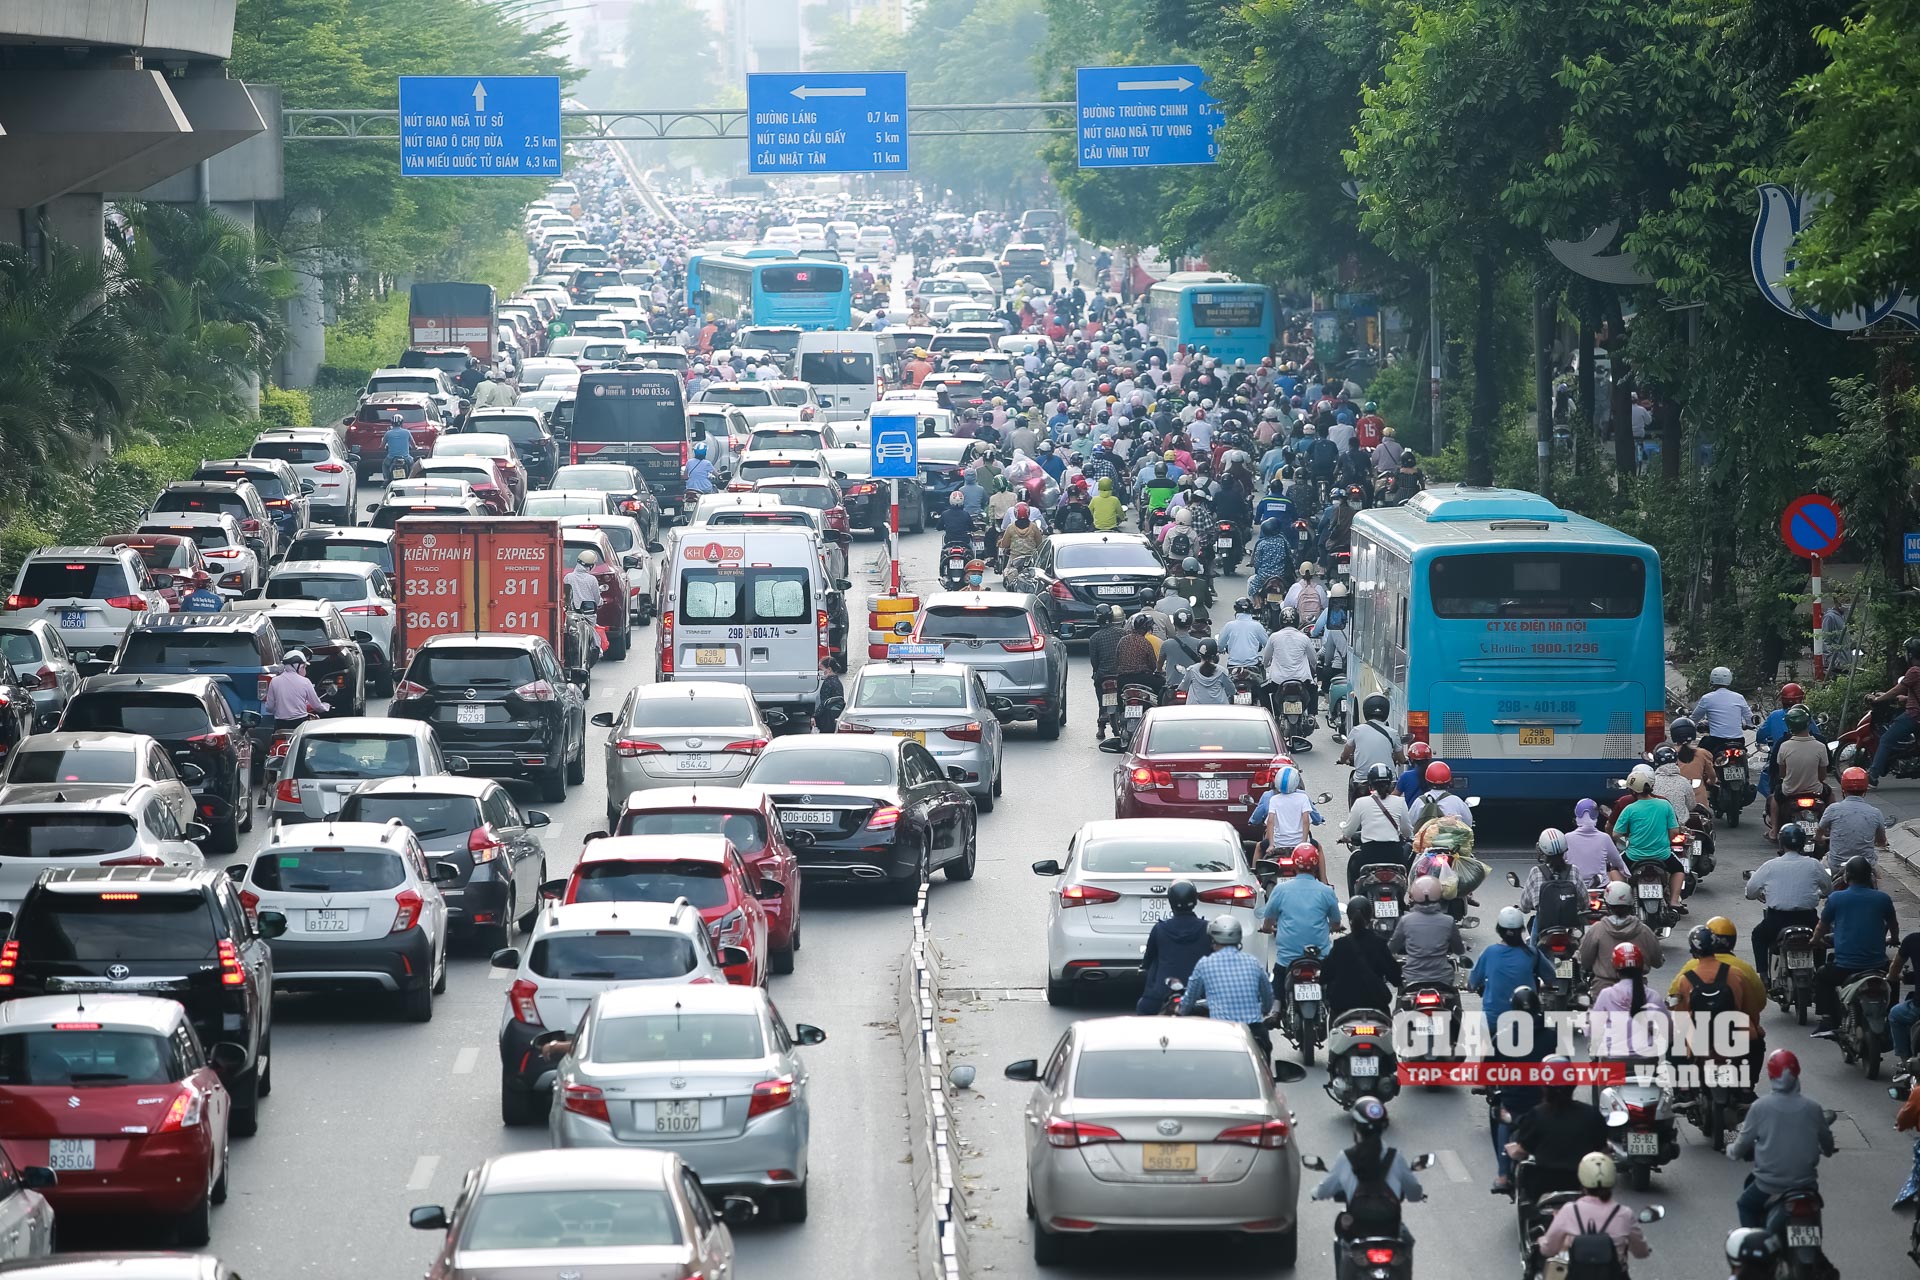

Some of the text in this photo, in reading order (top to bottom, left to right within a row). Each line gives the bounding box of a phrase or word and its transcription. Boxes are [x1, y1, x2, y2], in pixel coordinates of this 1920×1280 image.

[1083, 104, 1115, 118] ĐƯỜNG
[1119, 102, 1156, 118] TRƯỜNG
[1160, 104, 1188, 116] CHINH
[404, 112, 504, 127] NÚT GIAO NGÃ TƯ SỞ
[756, 110, 788, 124] ĐƯỜNG
[792, 109, 817, 124] LÁNG
[884, 112, 899, 123] km
[757, 128, 900, 145] NÚT GIAO CẦU GIẤY 5 km
[1084, 124, 1102, 139] NÚT
[1105, 126, 1126, 138] GIAO
[1129, 124, 1148, 138] NGÃ
[1150, 126, 1164, 137] TƯ
[1167, 124, 1192, 138] VỌNG
[1207, 124, 1213, 135] 3
[405, 133, 557, 150] NÚT GIAO Ô CHỢ DỪA 2.5 km
[758, 150, 900, 166] CẦU NHẬT TÂN 11 km
[1084, 144, 1102, 160] CẦU
[1106, 145, 1128, 158] VĨNH
[1132, 146, 1150, 158] TUY
[1208, 144, 1214, 156] 8
[406, 154, 424, 168] VĂN
[426, 152, 450, 168] MIẾU
[452, 152, 478, 168] QUỐC
[496, 153, 519, 168] GIÁM
[526, 156, 540, 168] 4.3
[542, 156, 558, 168] km
[796, 272, 808, 280] 02
[631, 388, 651, 396] 1900
[652, 388, 670, 396] 0336
[1364, 424, 1375, 438] 15
[404, 546, 545, 561] KIÊN THANH EXPRESS
[686, 548, 740, 557] KH 26
[405, 578, 538, 596] 33.81 .811
[67, 612, 81, 620] 29A
[406, 611, 538, 628] 36.61 .611
[62, 620, 85, 628] 005.01
[1487, 620, 1587, 634] CT XE ĐIỆN HÀ NỘI
[728, 628, 780, 639] 29B 604.74
[908, 645, 924, 653] SÔNG
[1491, 643, 1599, 653] Hotline 1900.1296
[699, 656, 723, 664] 604.74
[463, 705, 479, 714] 30F
[1498, 700, 1520, 713] 29B
[1534, 700, 1576, 713] 401.88
[1530, 728, 1545, 736] 29B
[1523, 736, 1551, 745] 401.88
[686, 753, 702, 761] 30G
[1205, 779, 1221, 789] 30E
[1199, 790, 1228, 799] 483.39
[782, 812, 831, 822] 30G-065.15
[1148, 900, 1166, 910] 30F
[318, 911, 336, 920] 30H
[310, 920, 344, 930] 817.72
[666, 1100, 689, 1116] 30E
[657, 1117, 698, 1131] 610.07
[60, 1140, 84, 1153] 30A
[50, 1155, 92, 1169] 835.04
